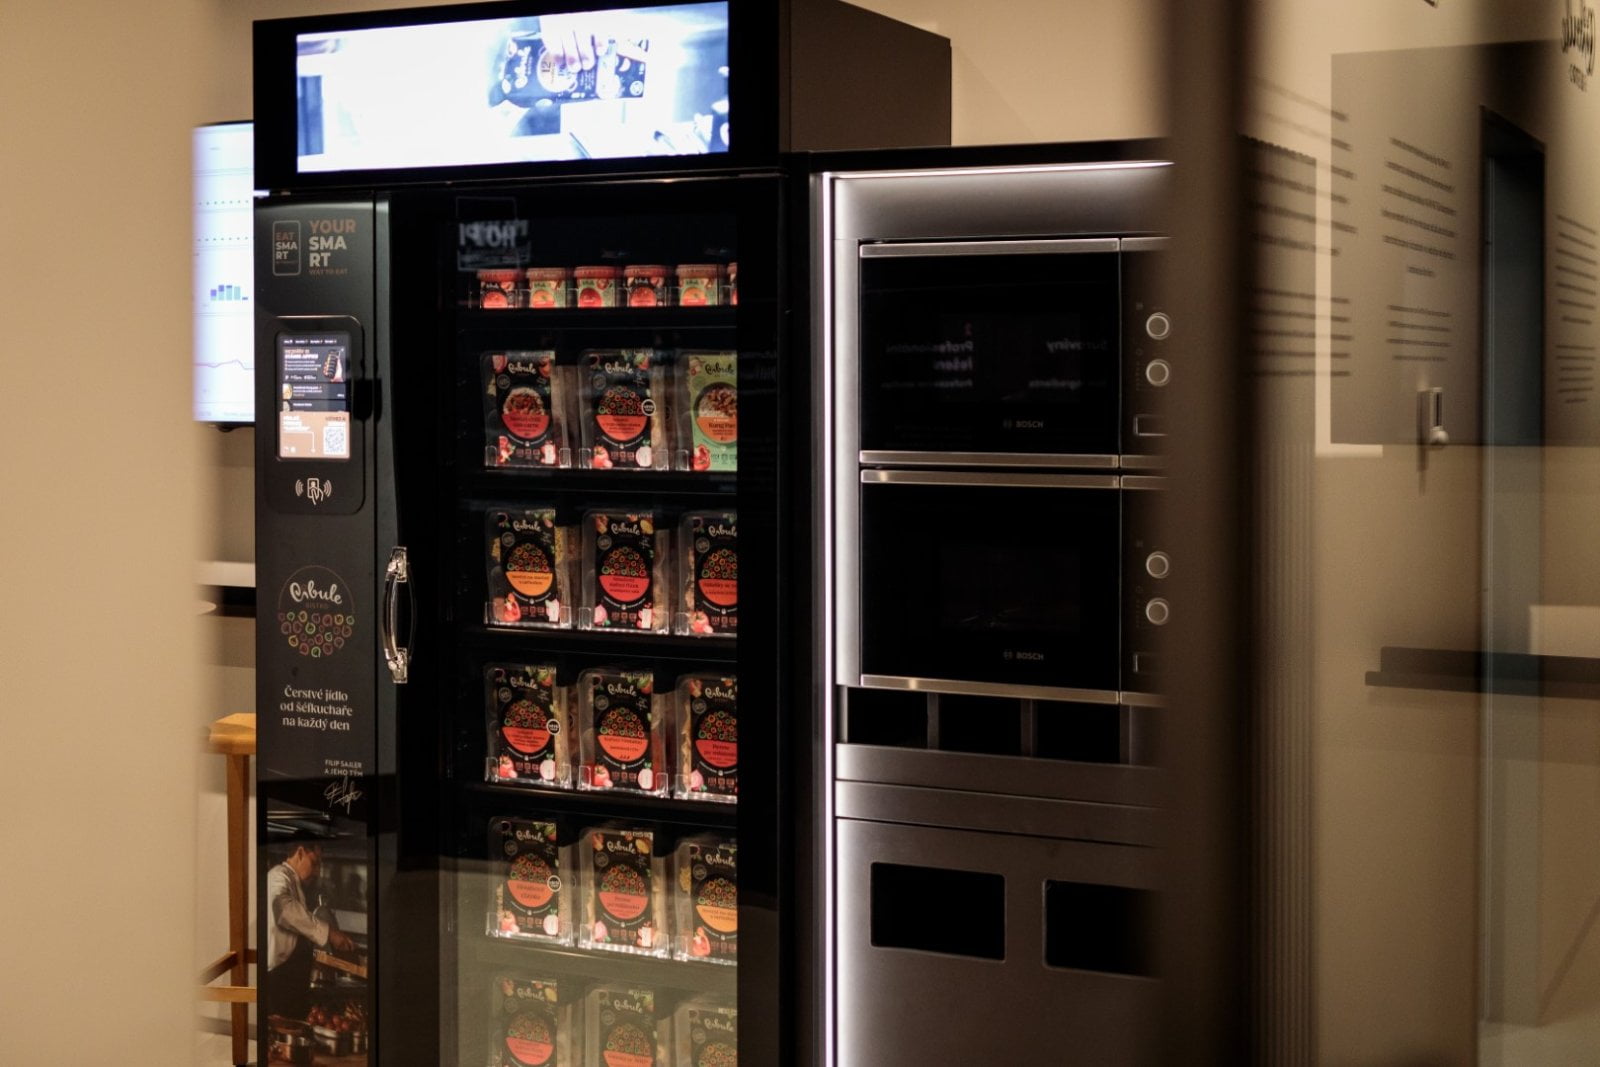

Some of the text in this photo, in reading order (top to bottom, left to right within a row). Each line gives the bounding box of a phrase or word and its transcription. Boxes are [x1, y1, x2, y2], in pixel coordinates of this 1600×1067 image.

[308, 219, 357, 234] YOUR
[276, 232, 295, 241] EAT
[308, 235, 347, 251] SMA
[275, 241, 298, 250] SMA
[276, 251, 289, 260] RT
[309, 252, 331, 267] RT
[1015, 420, 1044, 429] BOSCH
[289, 580, 342, 604] Cibule
[1016, 651, 1044, 661] BOSCH
[284, 685, 348, 702] Čerstvé jídlo
[280, 702, 352, 716] od šéfkuchaře
[282, 717, 350, 731] na každý den
